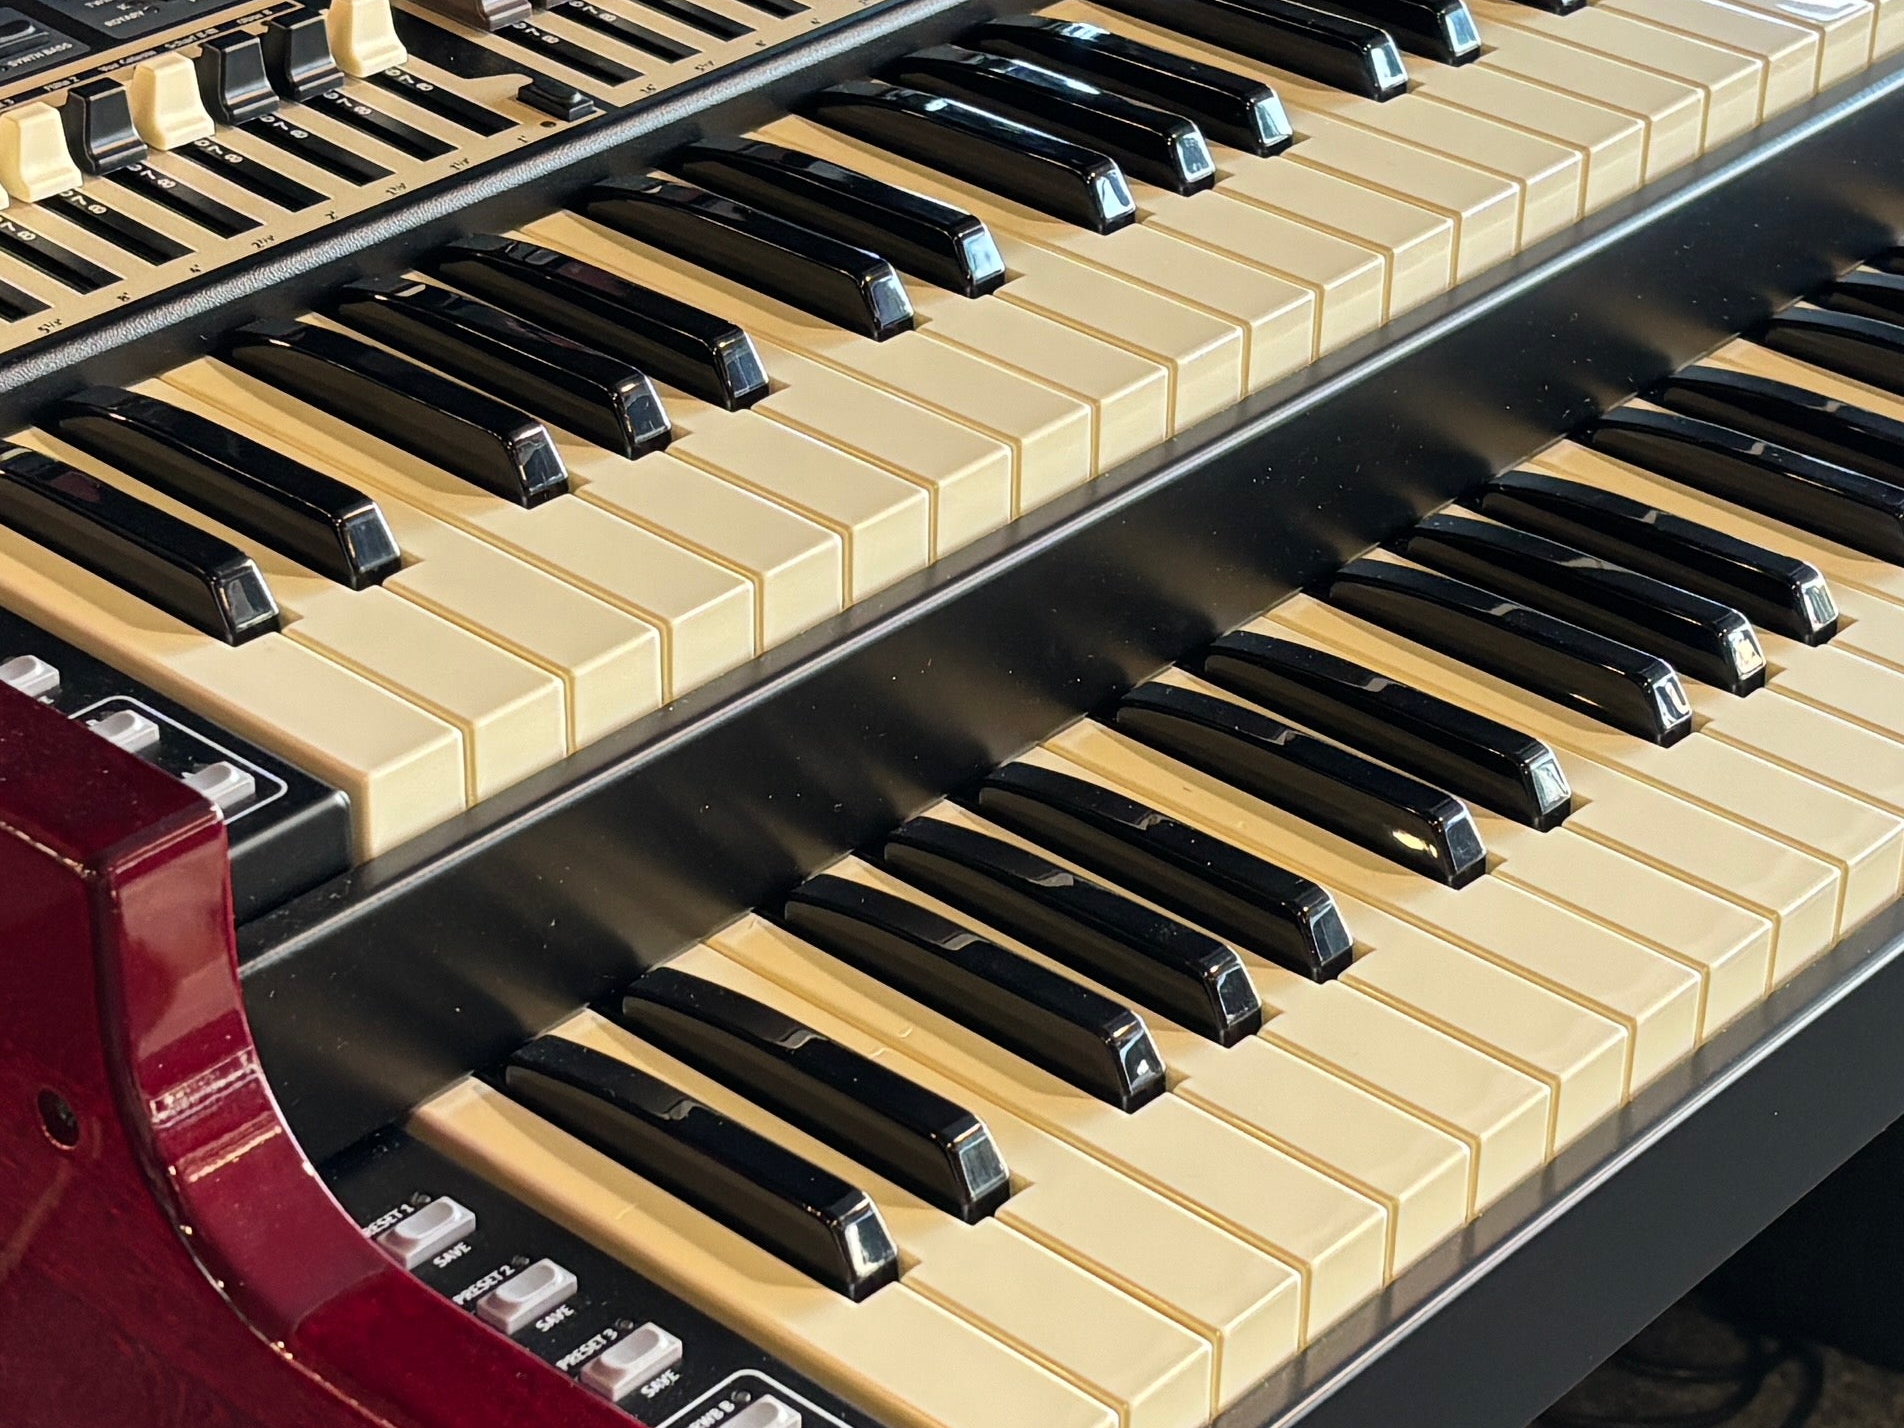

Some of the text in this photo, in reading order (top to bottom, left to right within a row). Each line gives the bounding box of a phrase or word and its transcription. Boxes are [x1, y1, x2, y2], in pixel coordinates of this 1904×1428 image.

[433, 1241, 471, 1268] SAVE
[452, 1264, 516, 1305] PRESET 2
[535, 1304, 574, 1332] SAVE
[555, 1327, 618, 1372] PRESET 3
[641, 1370, 680, 1399] SAVE
[721, 1399, 736, 1414] B
